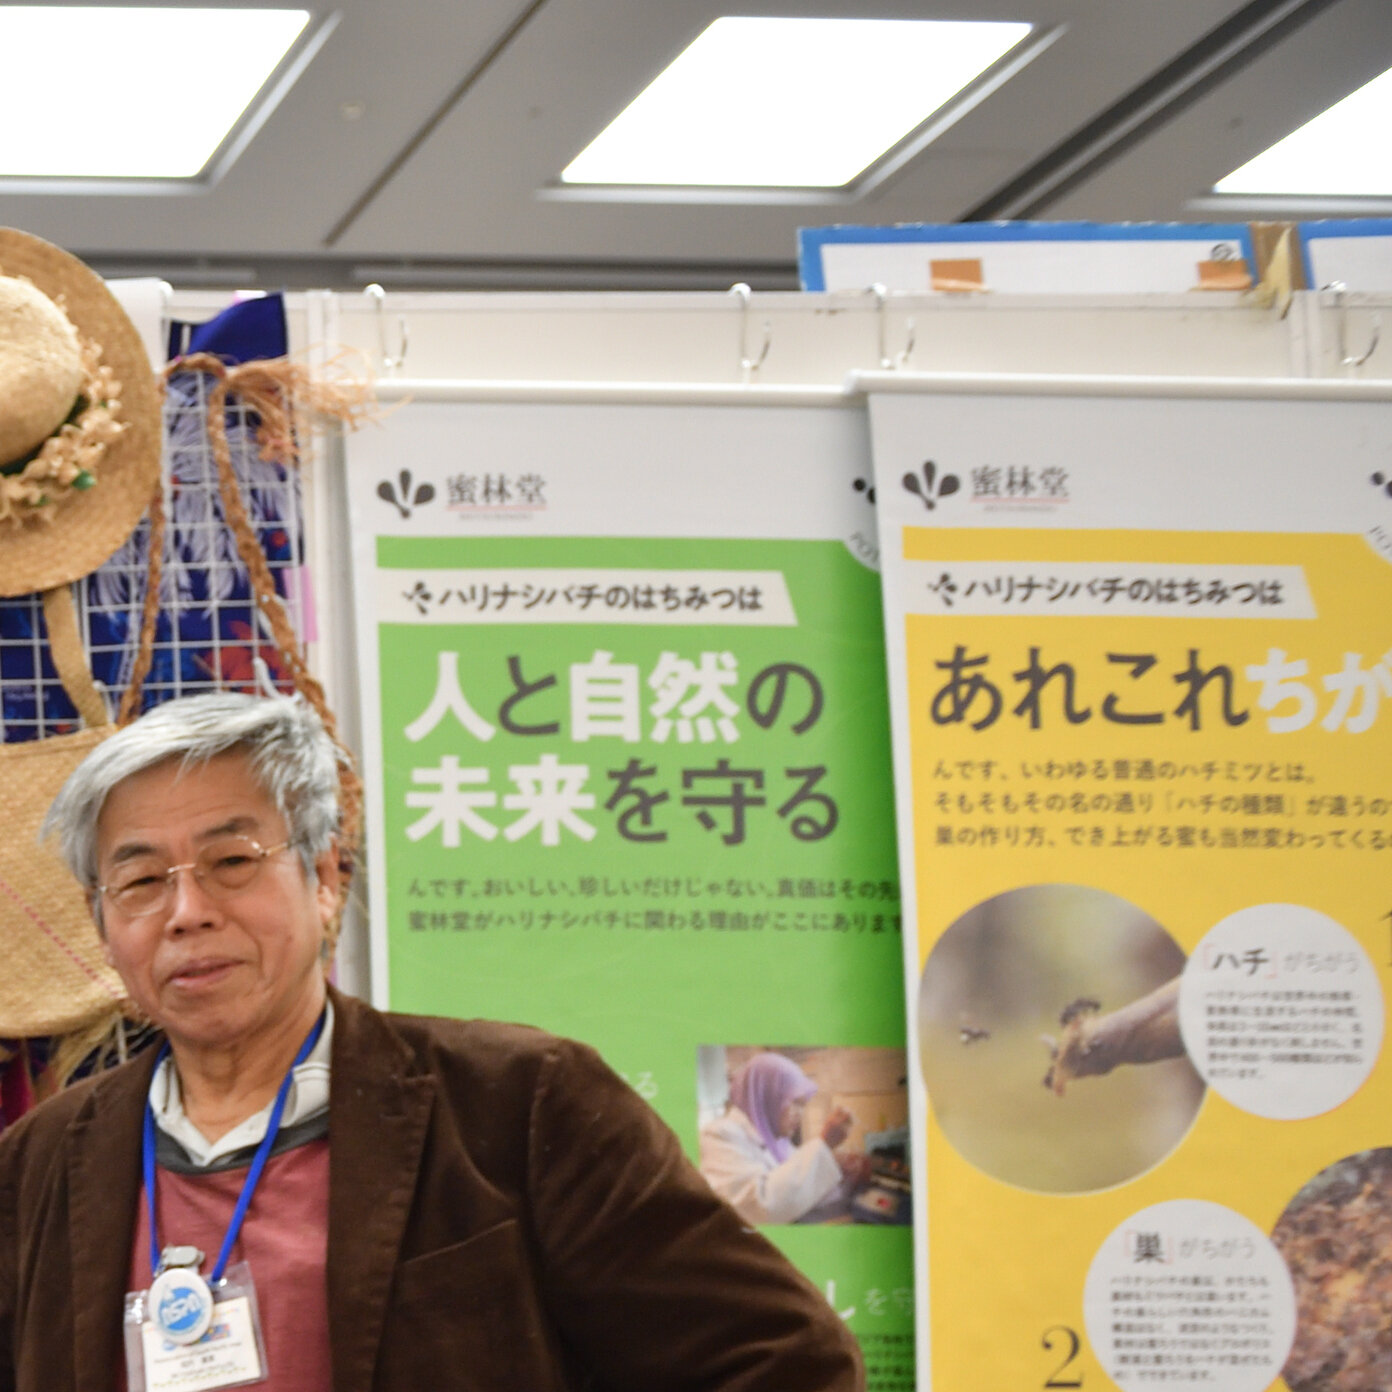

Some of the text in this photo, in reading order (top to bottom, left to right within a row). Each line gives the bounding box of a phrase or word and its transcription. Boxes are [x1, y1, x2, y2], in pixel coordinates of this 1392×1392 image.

[445, 473, 548, 506] 蜜林堂
[970, 465, 1071, 498] 蜜林堂
[438, 583, 764, 612] ハリナシバチのはちみつは
[964, 578, 1285, 606] ハリナシバチのはちみつは
[403, 649, 825, 744] 人と自然の
[930, 643, 1392, 734] あれこれちが
[404, 753, 841, 848] 未来を守る
[1041, 1325, 1085, 1389] 2
